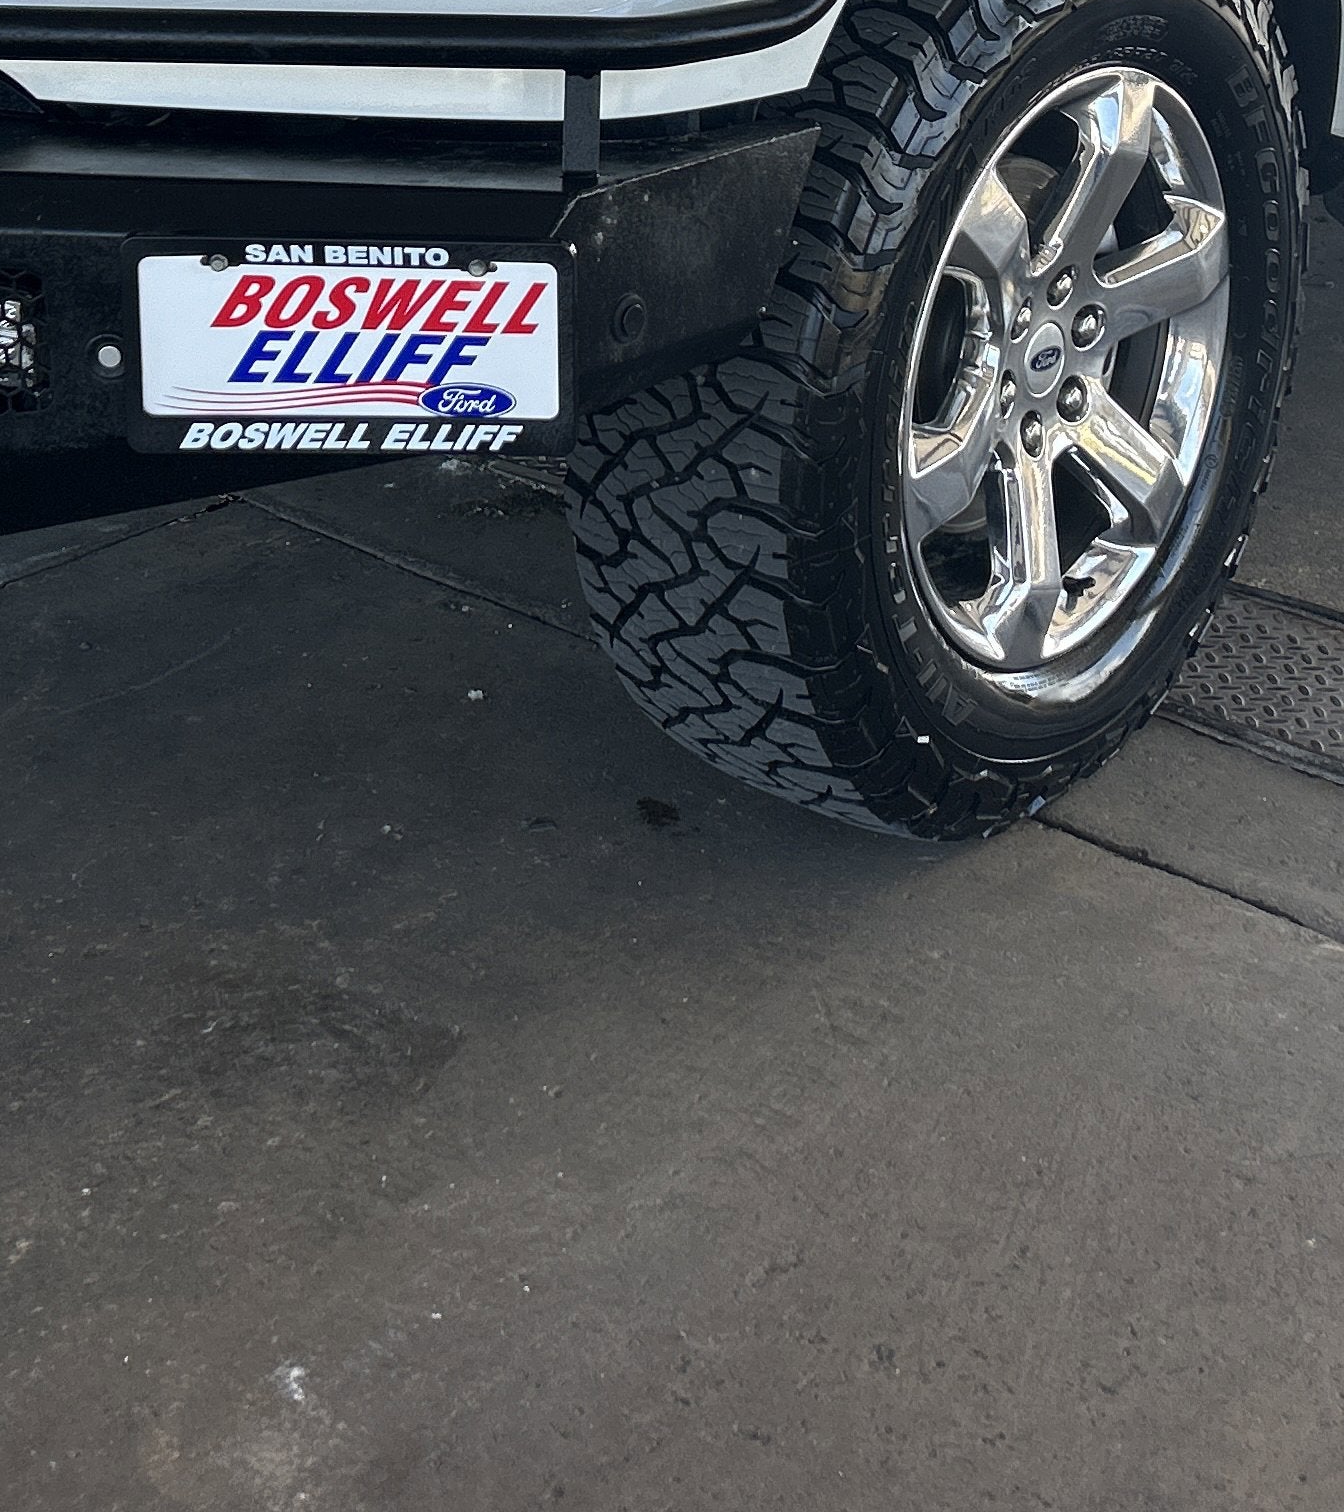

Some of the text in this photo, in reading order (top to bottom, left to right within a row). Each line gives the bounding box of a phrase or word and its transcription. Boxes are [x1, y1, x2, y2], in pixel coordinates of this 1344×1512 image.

[245, 244, 450, 267] SAN BENITO
[210, 274, 547, 334] BOSWELL
[227, 330, 491, 387] ELLIFF
[438, 388, 497, 413] Ford
[179, 422, 524, 452] BOSWELL ELLIFF
